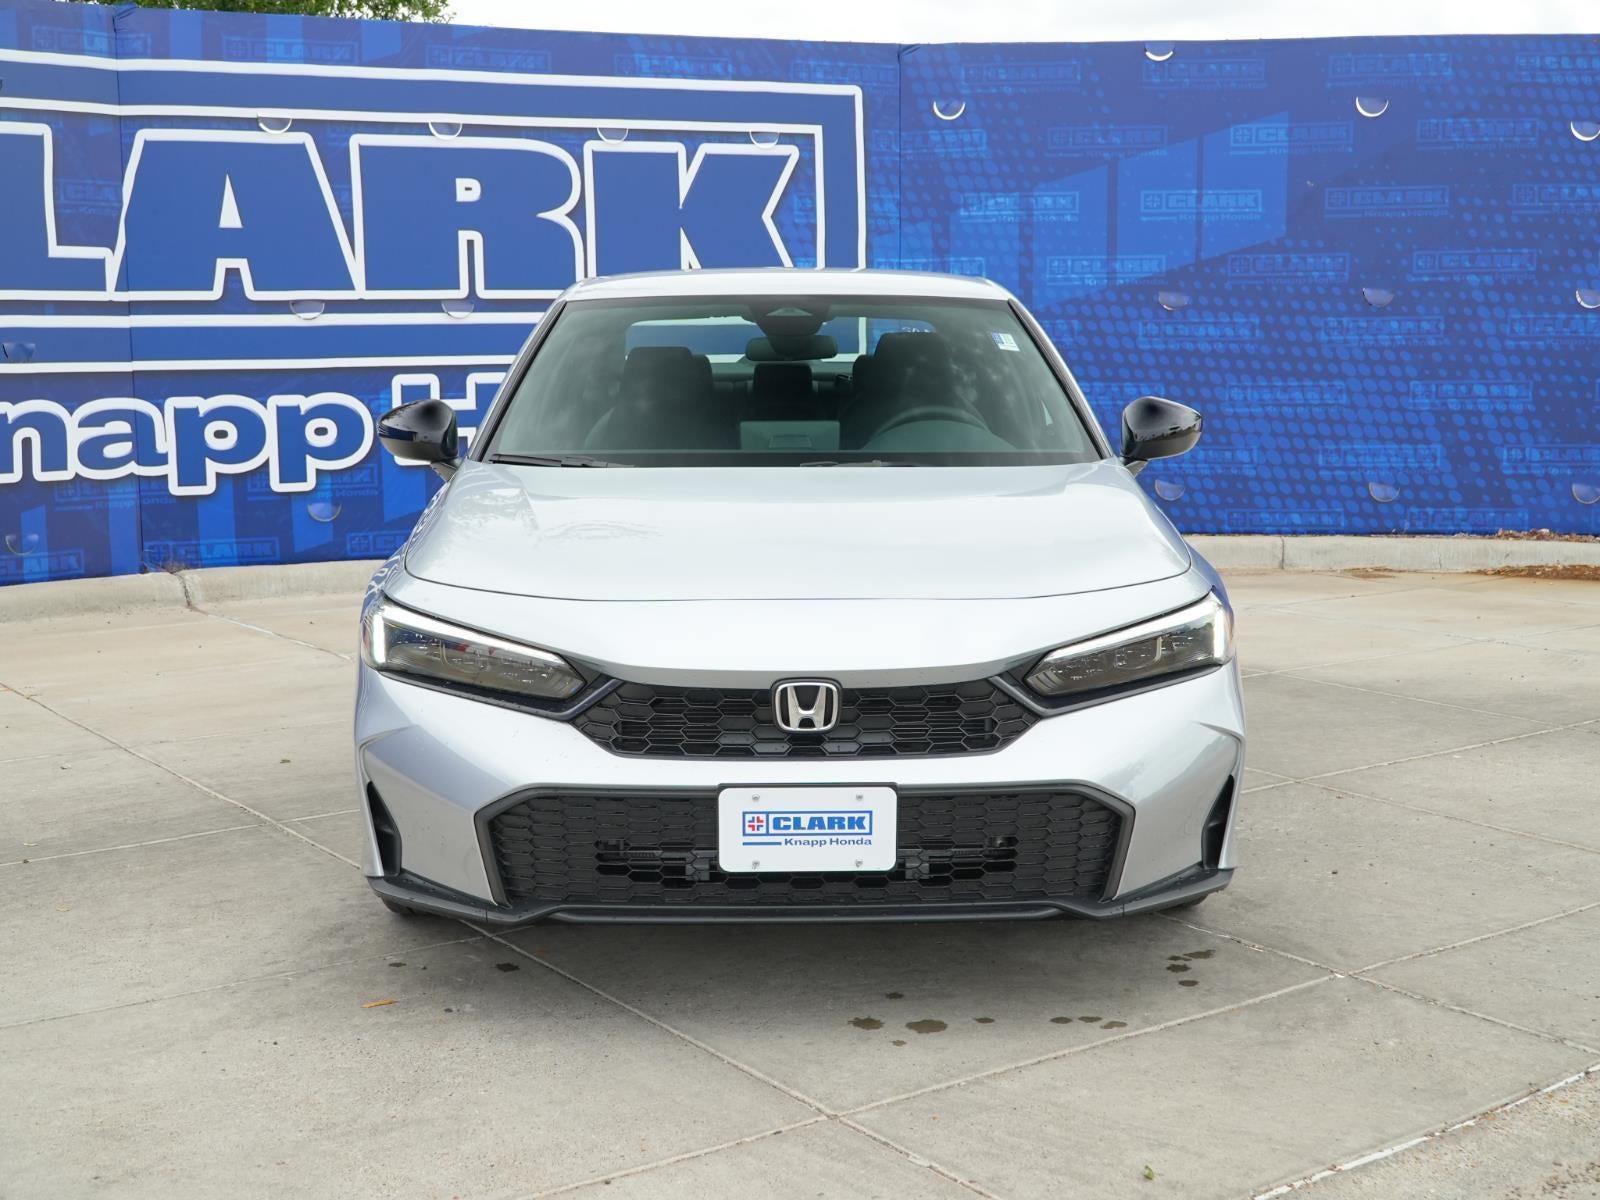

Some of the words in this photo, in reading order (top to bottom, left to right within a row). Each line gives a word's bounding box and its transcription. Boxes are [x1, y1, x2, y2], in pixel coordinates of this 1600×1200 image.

[772, 815, 866, 831] CLARK
[784, 837, 827, 848] Knapp
[829, 836, 872, 847] Honda
